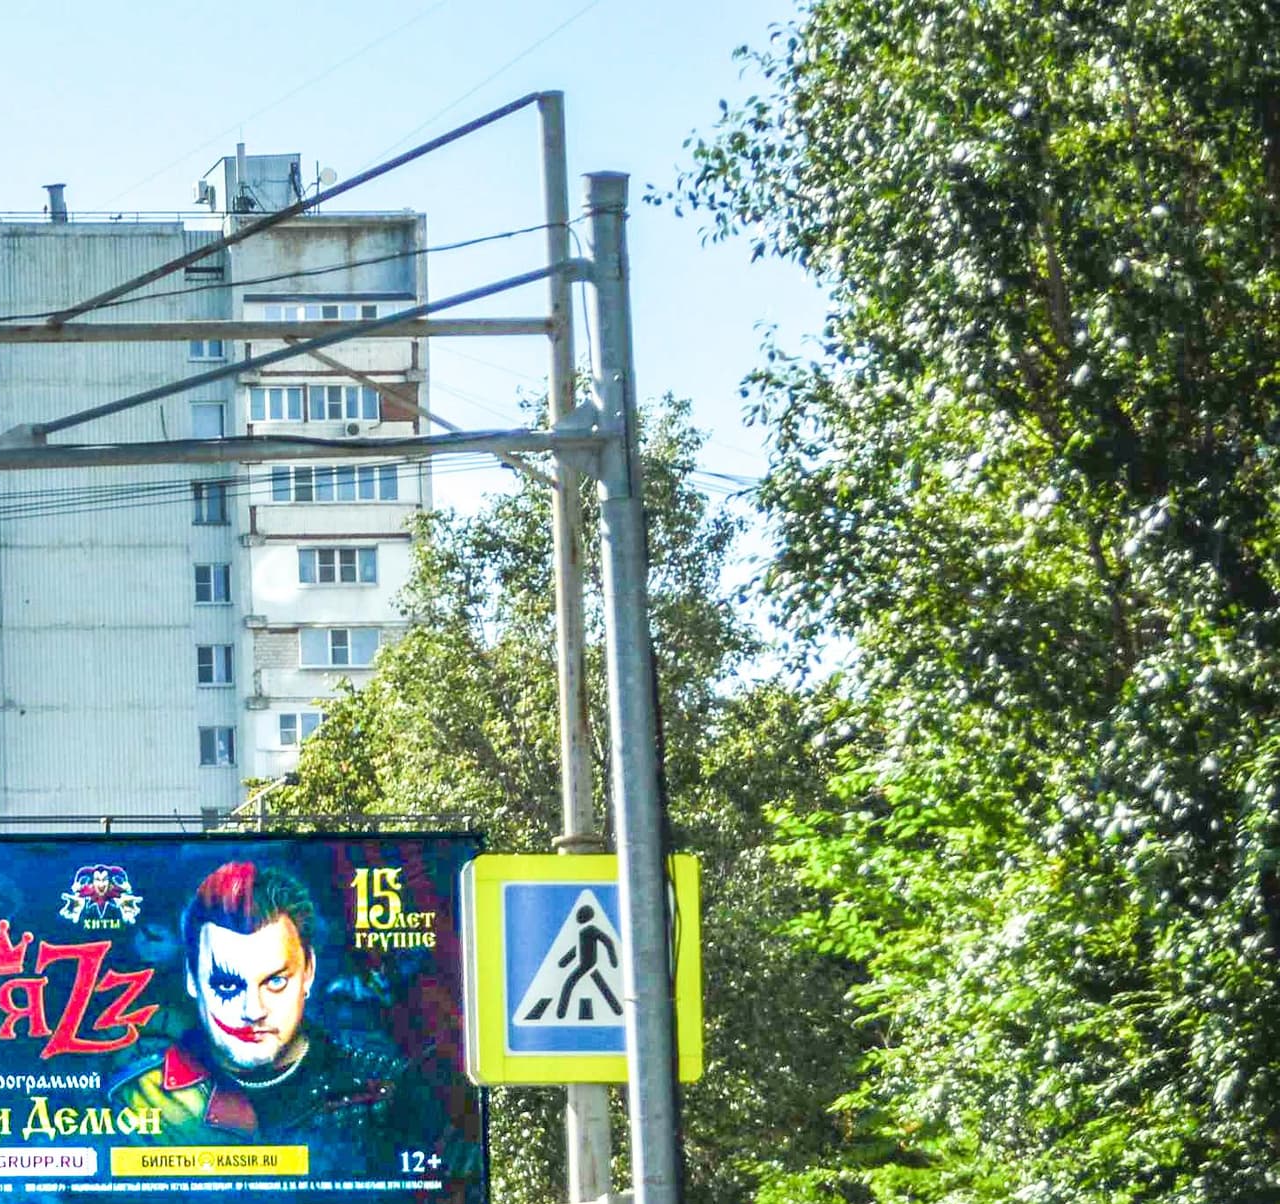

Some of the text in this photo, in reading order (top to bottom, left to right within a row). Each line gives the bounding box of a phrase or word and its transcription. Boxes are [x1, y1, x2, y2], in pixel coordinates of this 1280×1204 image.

[350, 867, 402, 930] 15
[141, 1154, 278, 1168] БИЛЕТЫ KASSIR.RU
[400, 1150, 443, 1173] 12+
